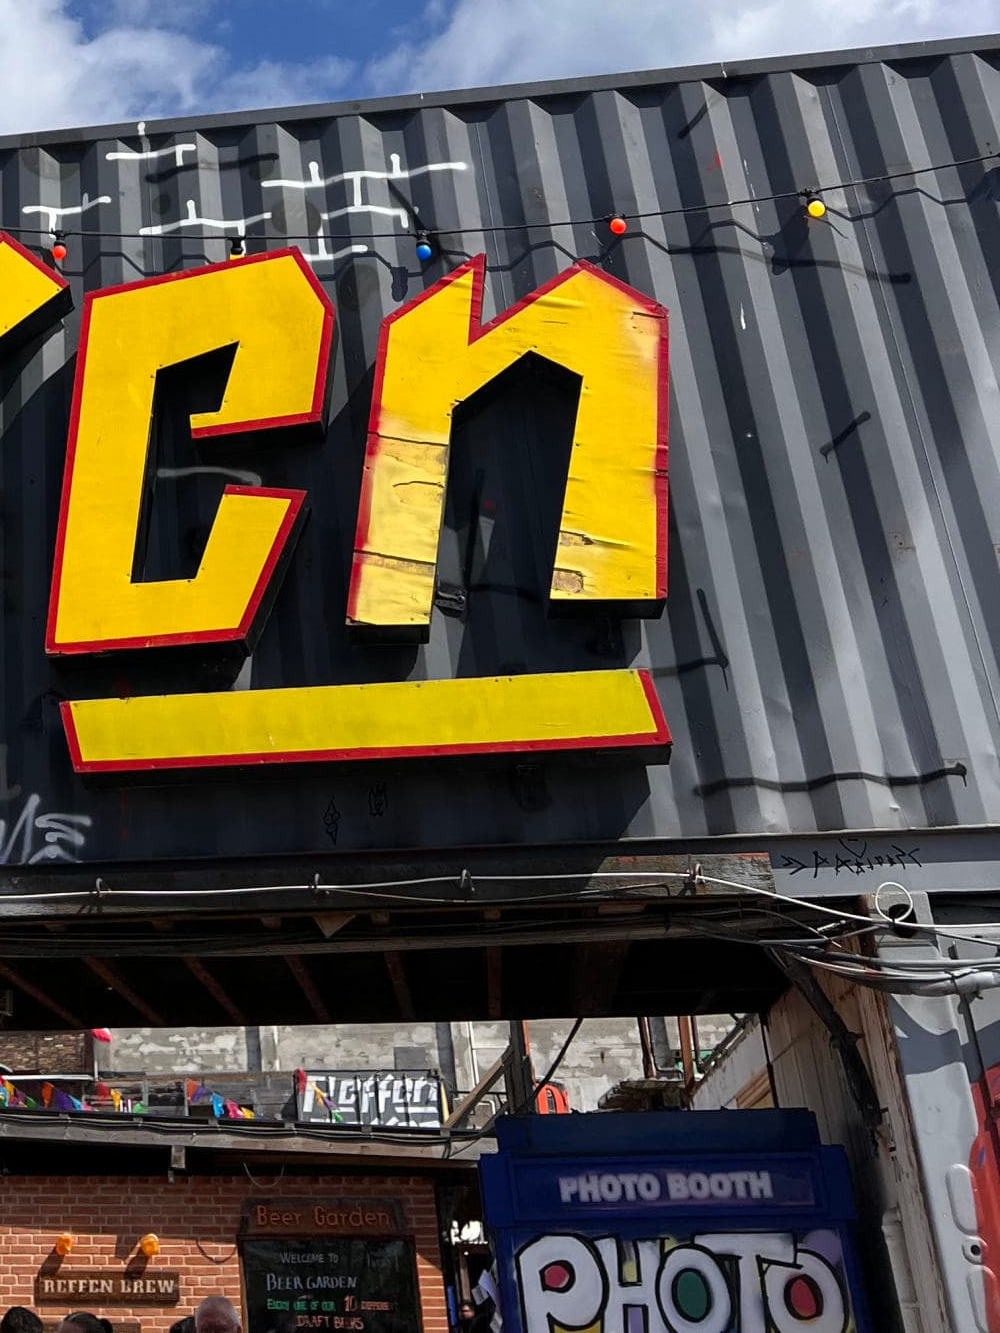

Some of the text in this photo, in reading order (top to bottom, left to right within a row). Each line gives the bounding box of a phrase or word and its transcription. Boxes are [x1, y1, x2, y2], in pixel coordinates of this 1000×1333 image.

[558, 1169, 774, 1202] PHOTO BOOTH
[256, 1203, 390, 1227] Beer Garden
[44, 1279, 175, 1294] REFFEN BREW
[266, 1272, 358, 1291] BEER GARDEN
[514, 1231, 850, 1333] PHOTO
